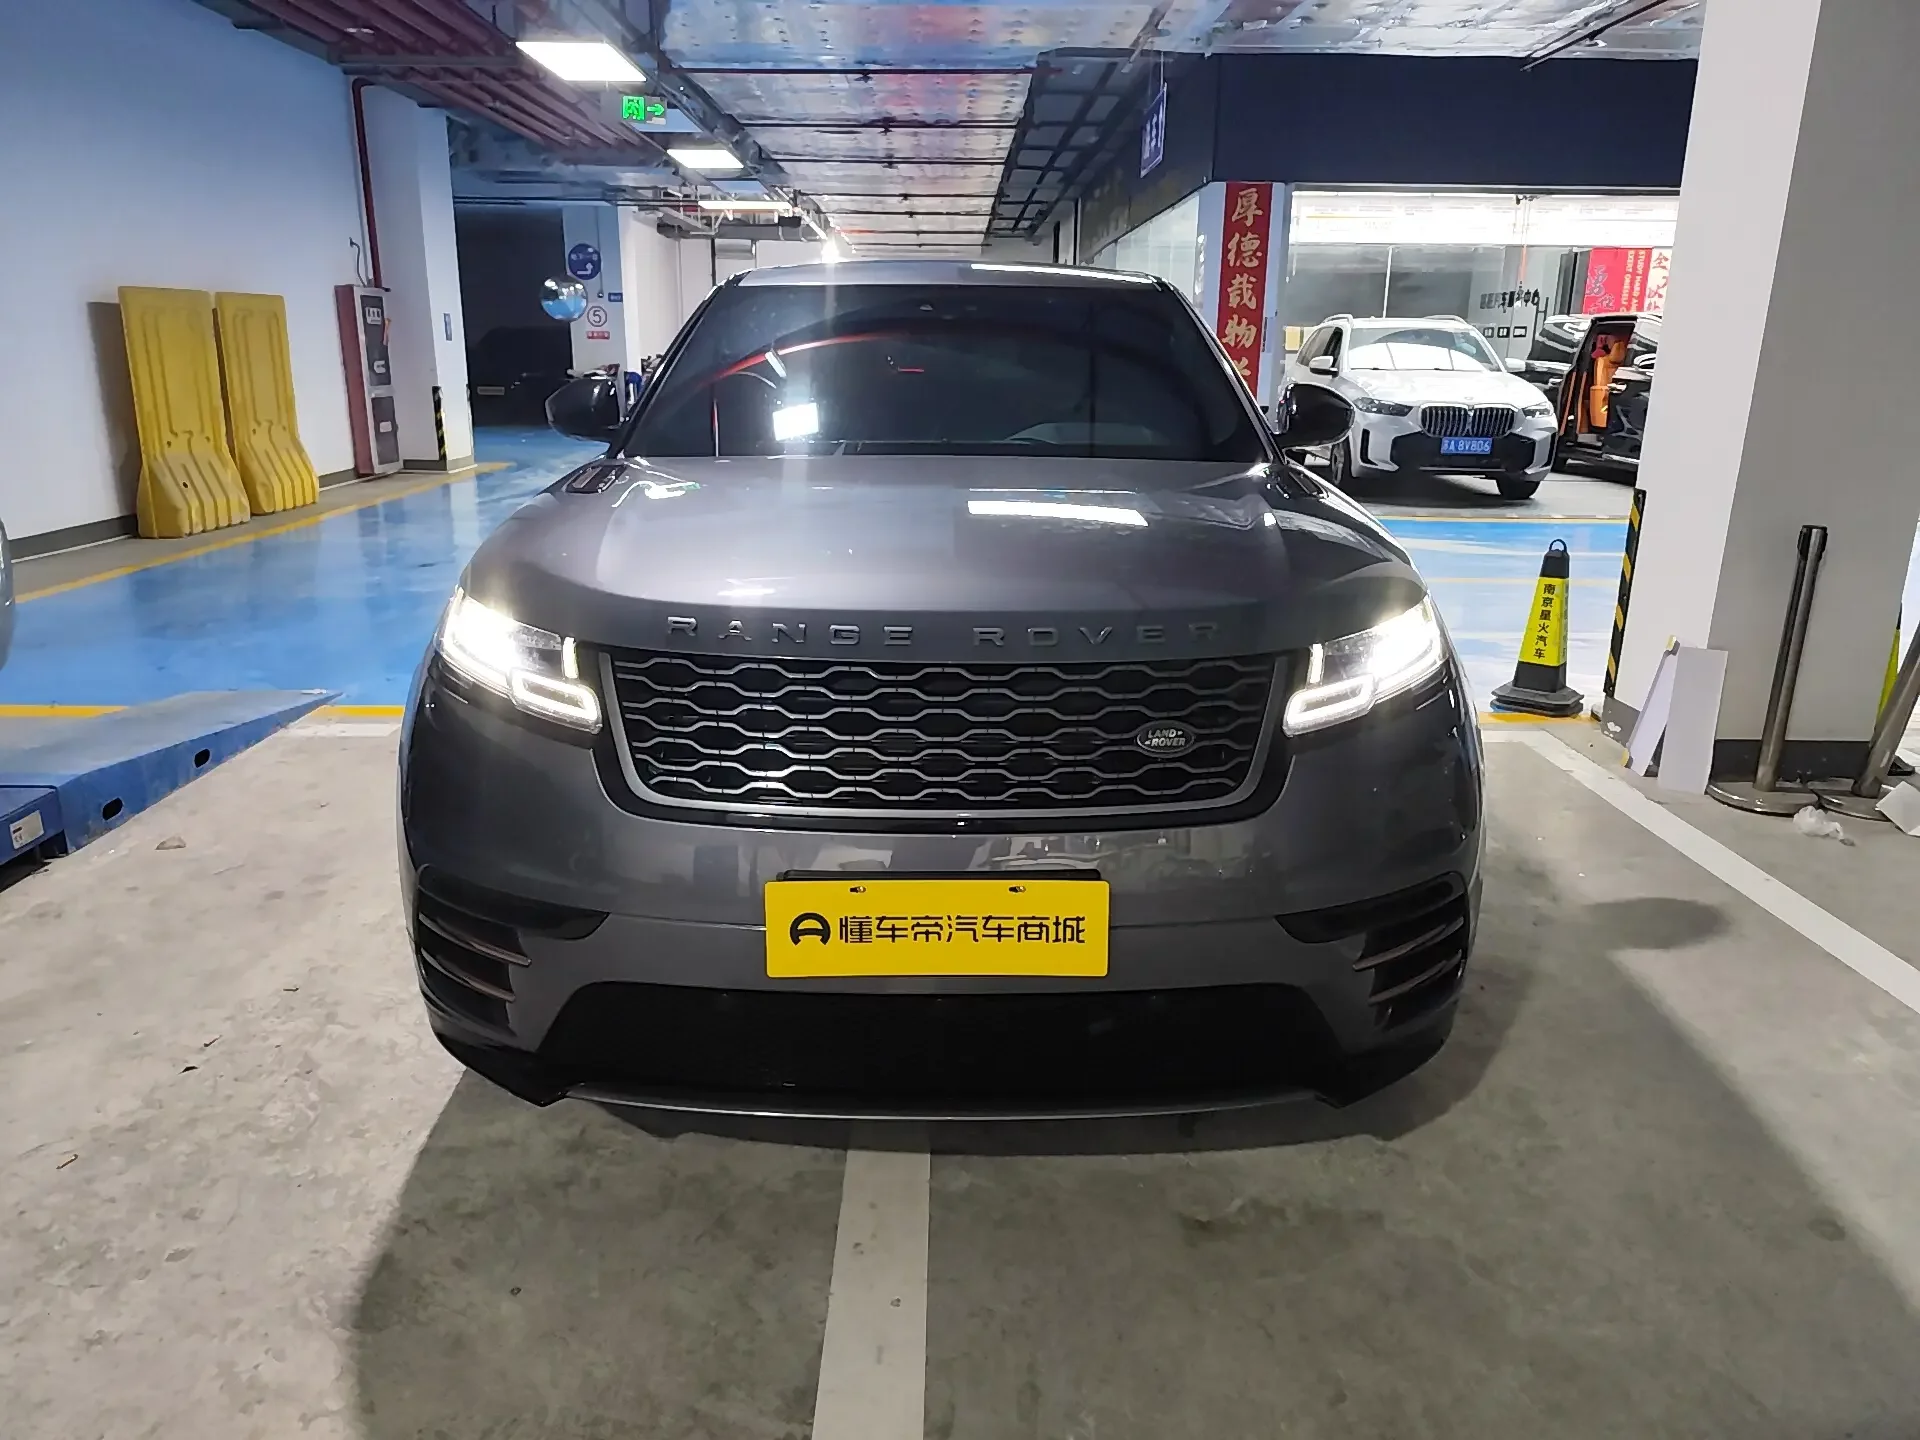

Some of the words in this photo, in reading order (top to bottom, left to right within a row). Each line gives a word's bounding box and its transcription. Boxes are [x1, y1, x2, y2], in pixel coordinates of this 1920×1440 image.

[666, 616, 914, 646] RANGE
[971, 621, 1220, 647] ROVER
[1532, 583, 1557, 660] 南京星火汽车
[1147, 728, 1177, 739] LAND
[1150, 737, 1186, 747] ROVER
[838, 914, 1087, 945] 懂车帝汽车商城
